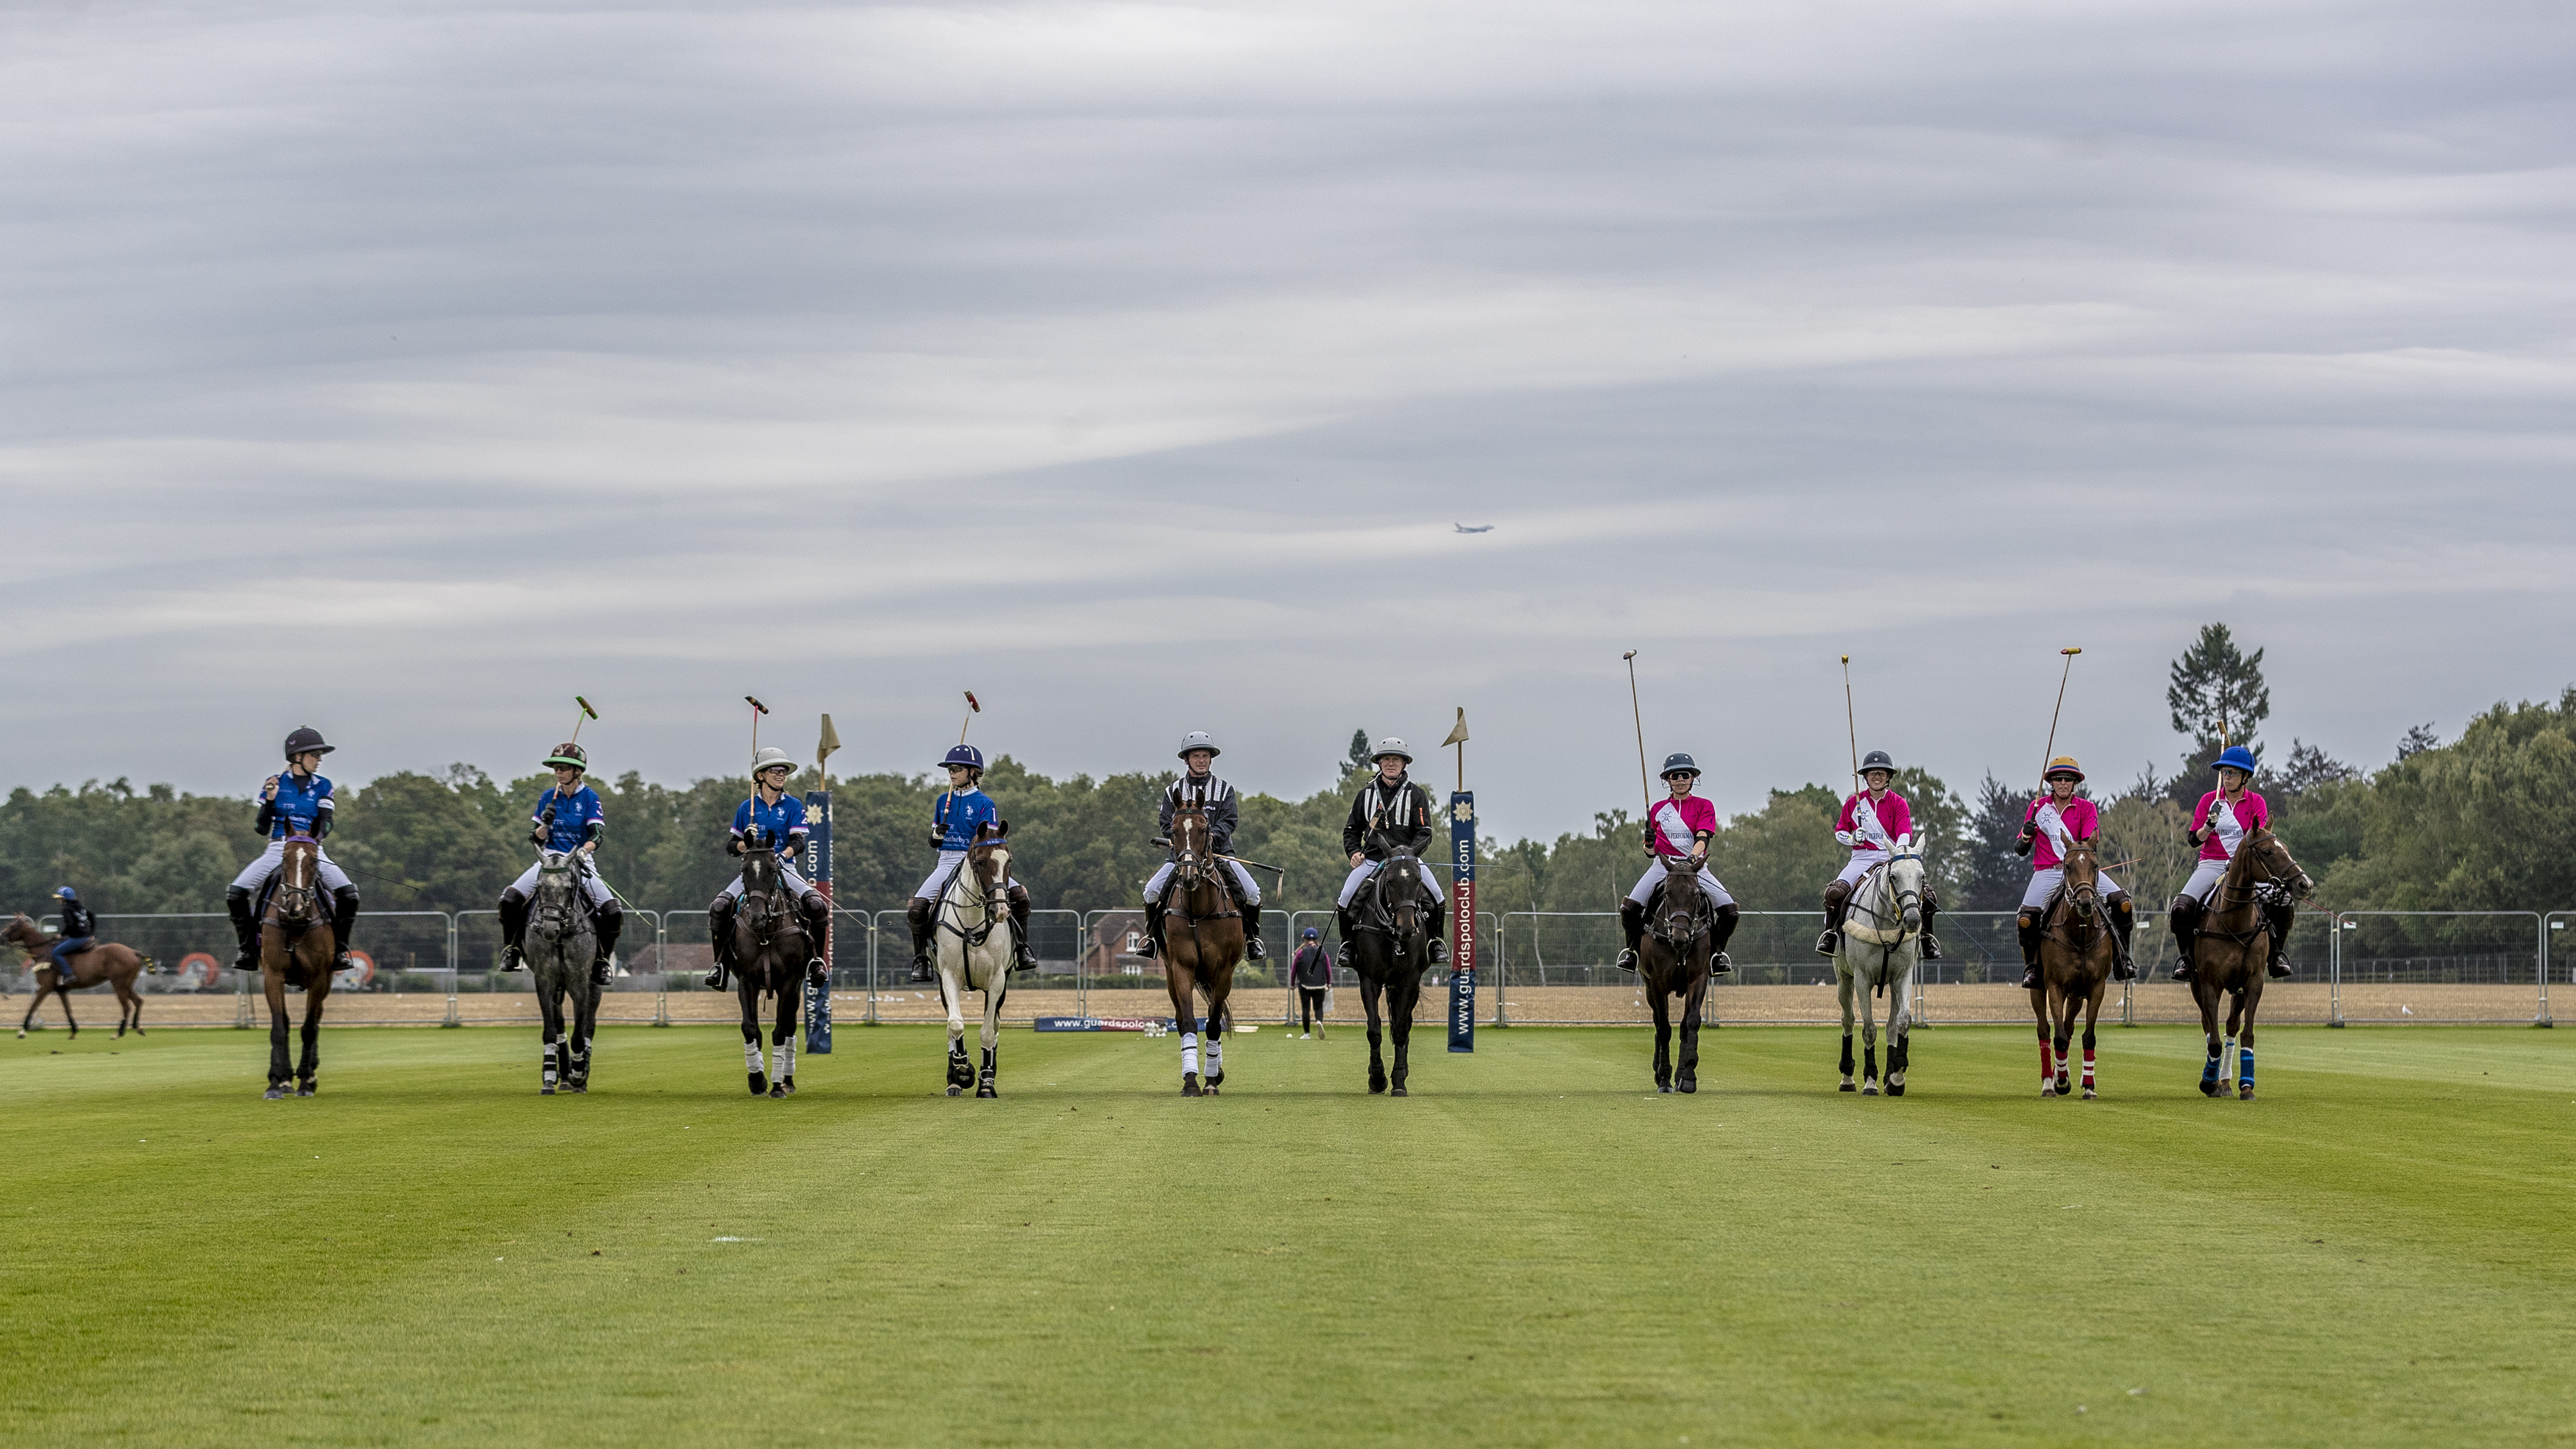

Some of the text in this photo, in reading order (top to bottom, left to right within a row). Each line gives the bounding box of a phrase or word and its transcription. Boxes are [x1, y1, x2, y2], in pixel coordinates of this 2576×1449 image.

[595, 801, 604, 817] 3
[991, 807, 997, 823] 1
[1458, 840, 1472, 1035] www.guardspoloclub.com
